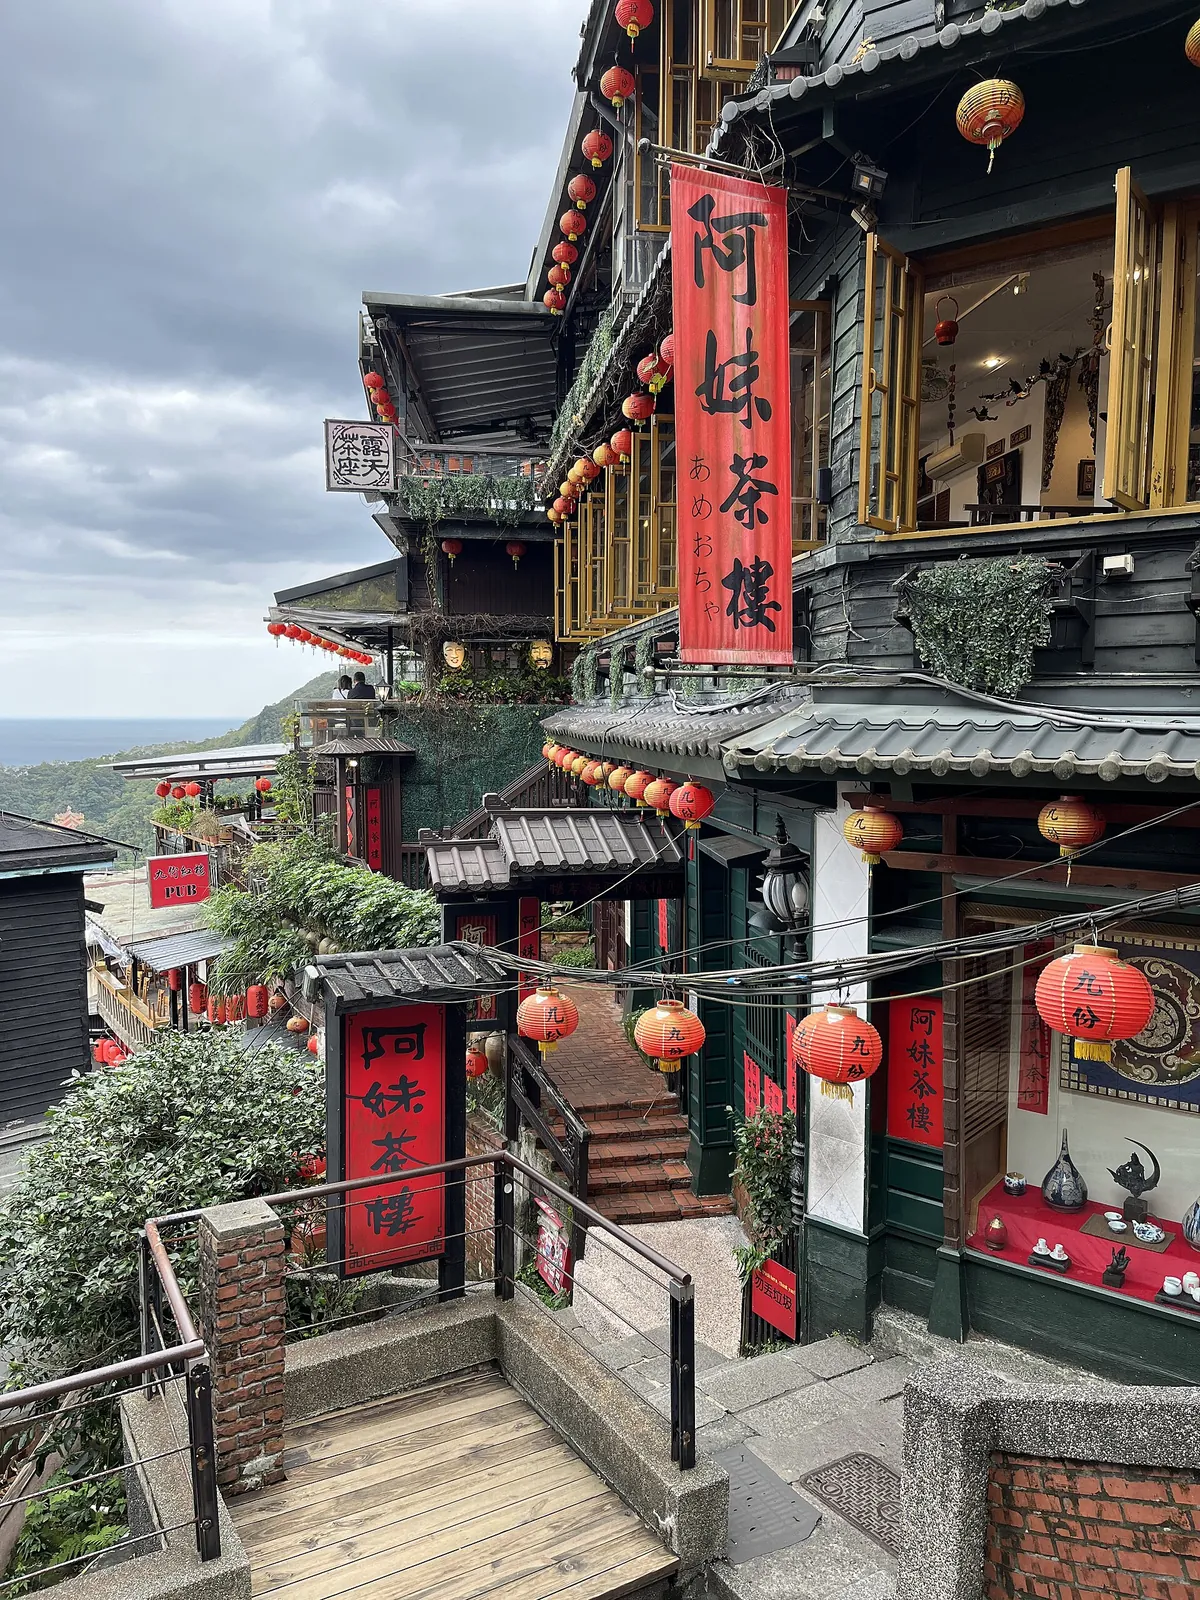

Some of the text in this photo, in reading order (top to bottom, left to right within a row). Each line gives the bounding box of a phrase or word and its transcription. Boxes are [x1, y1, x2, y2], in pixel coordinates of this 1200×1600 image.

[687, 193, 783, 632] 阿妹茶樓
[689, 454, 721, 622] あめおちゃ
[681, 791, 695, 818] 九份
[1046, 807, 1060, 841] 九份
[854, 818, 866, 847] 九份
[165, 884, 197, 899] PUB
[1073, 970, 1103, 1029] 九份
[545, 1006, 565, 1041] 九份
[667, 1027, 686, 1056] 九份
[846, 1035, 870, 1079] 九份
[906, 1007, 937, 1134] 阿妹茶樓
[361, 1022, 428, 1237] 阿妹茶樓
[754, 1273, 793, 1312] 勿丟垃圾
